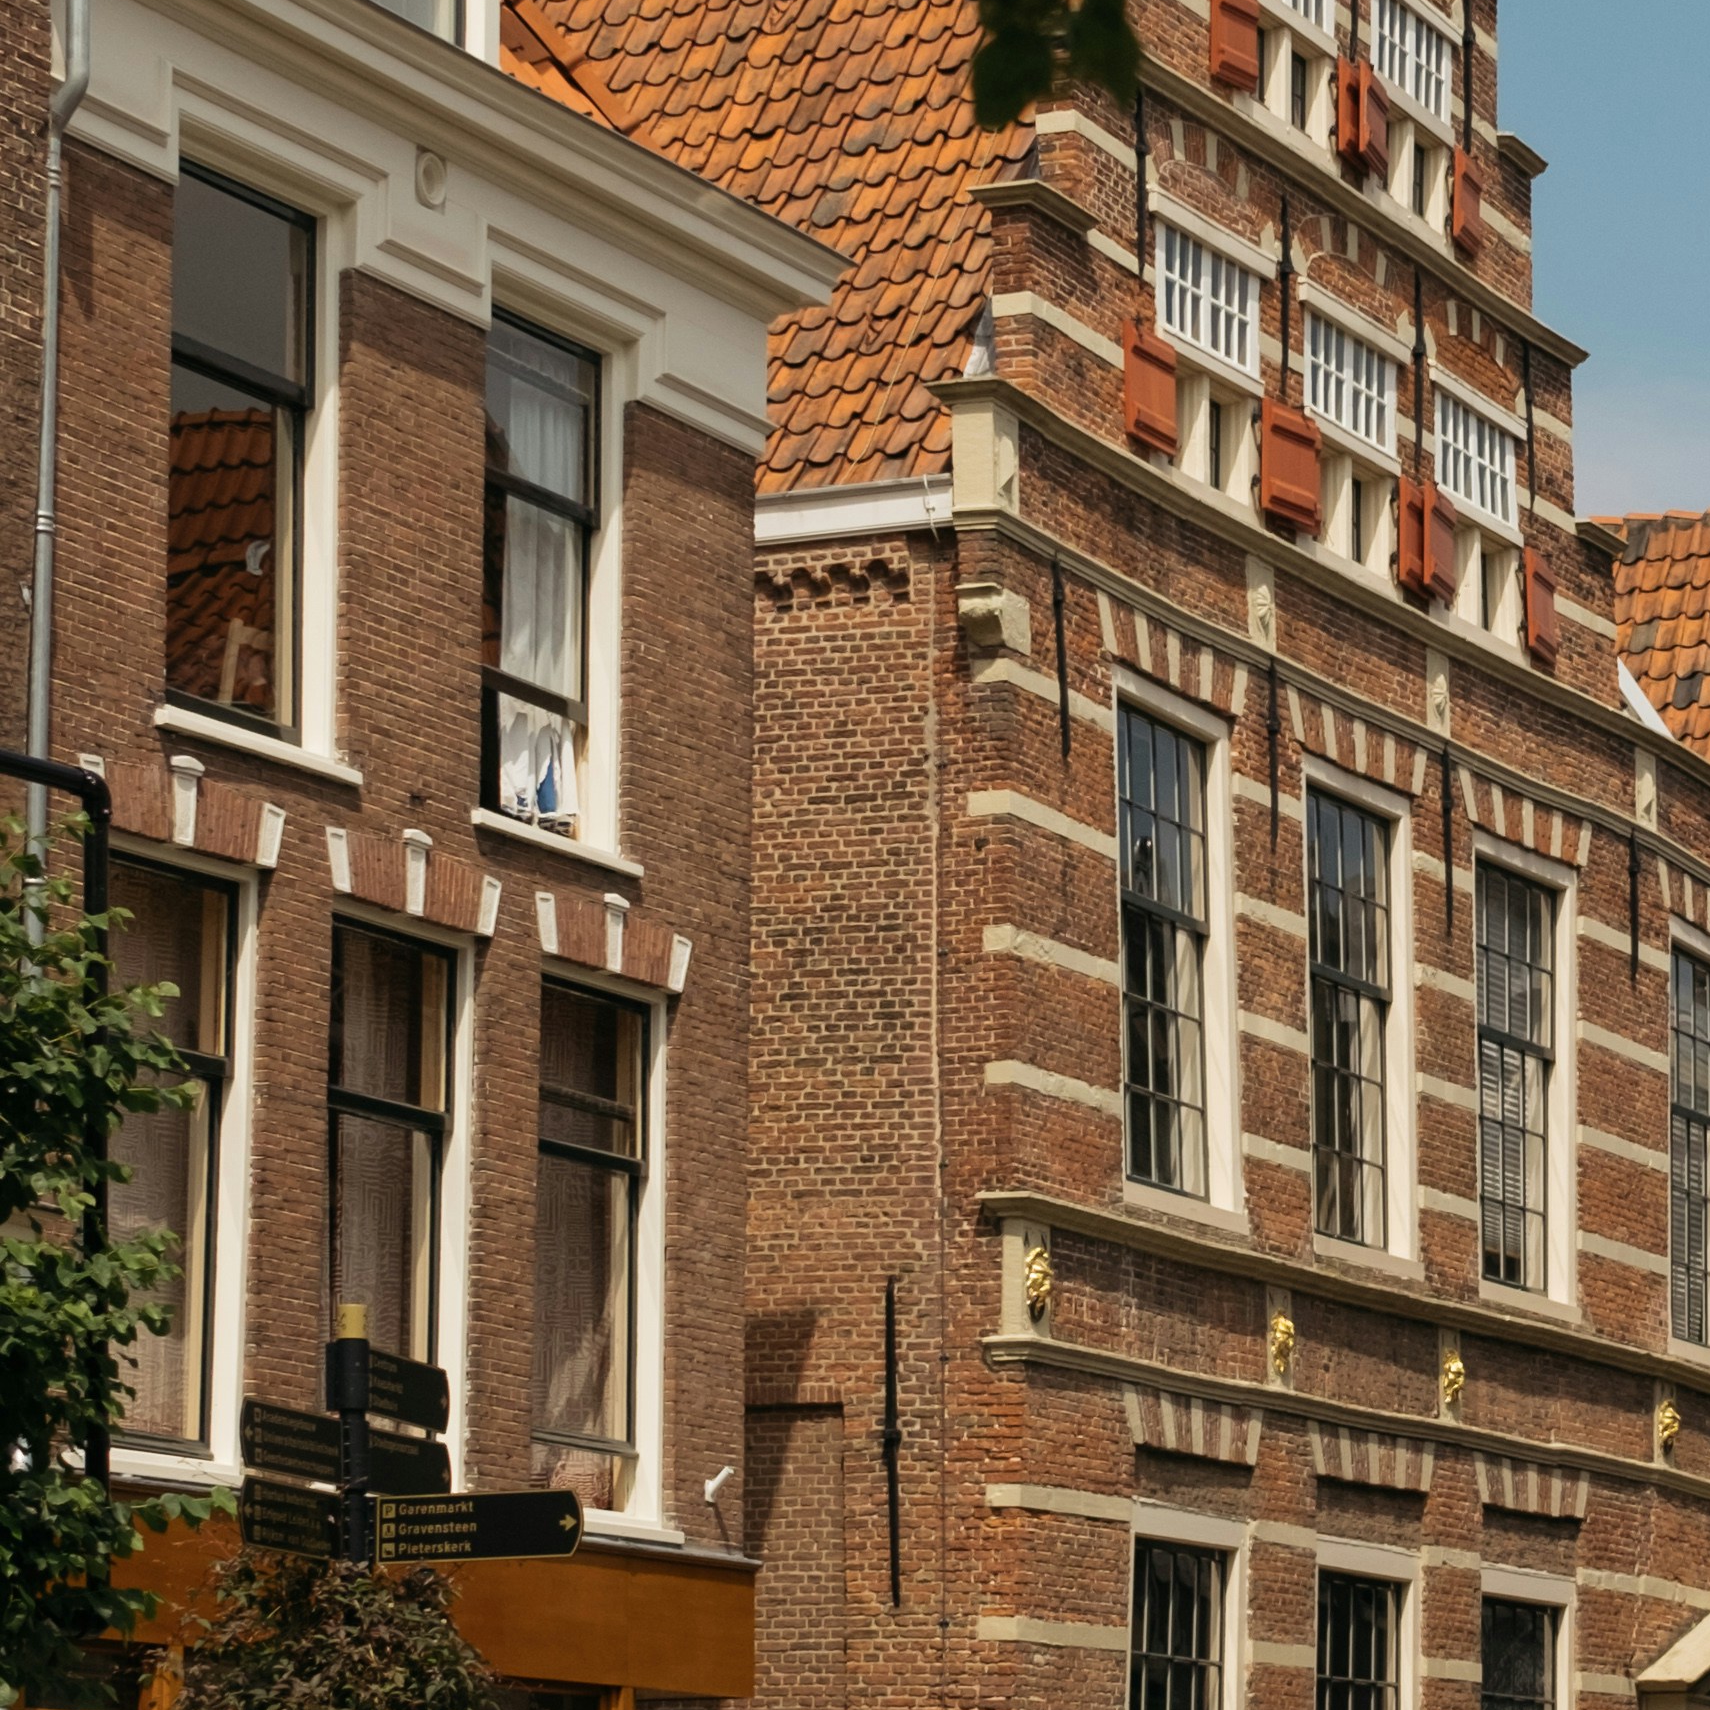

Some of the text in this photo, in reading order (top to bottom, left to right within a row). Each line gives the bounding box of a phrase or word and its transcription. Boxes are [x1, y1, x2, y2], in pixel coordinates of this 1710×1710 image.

[398, 1500, 475, 1516] Garenmarkt
[398, 1521, 478, 1536] Gravensteen
[398, 1539, 472, 1555] Pieterskerk
